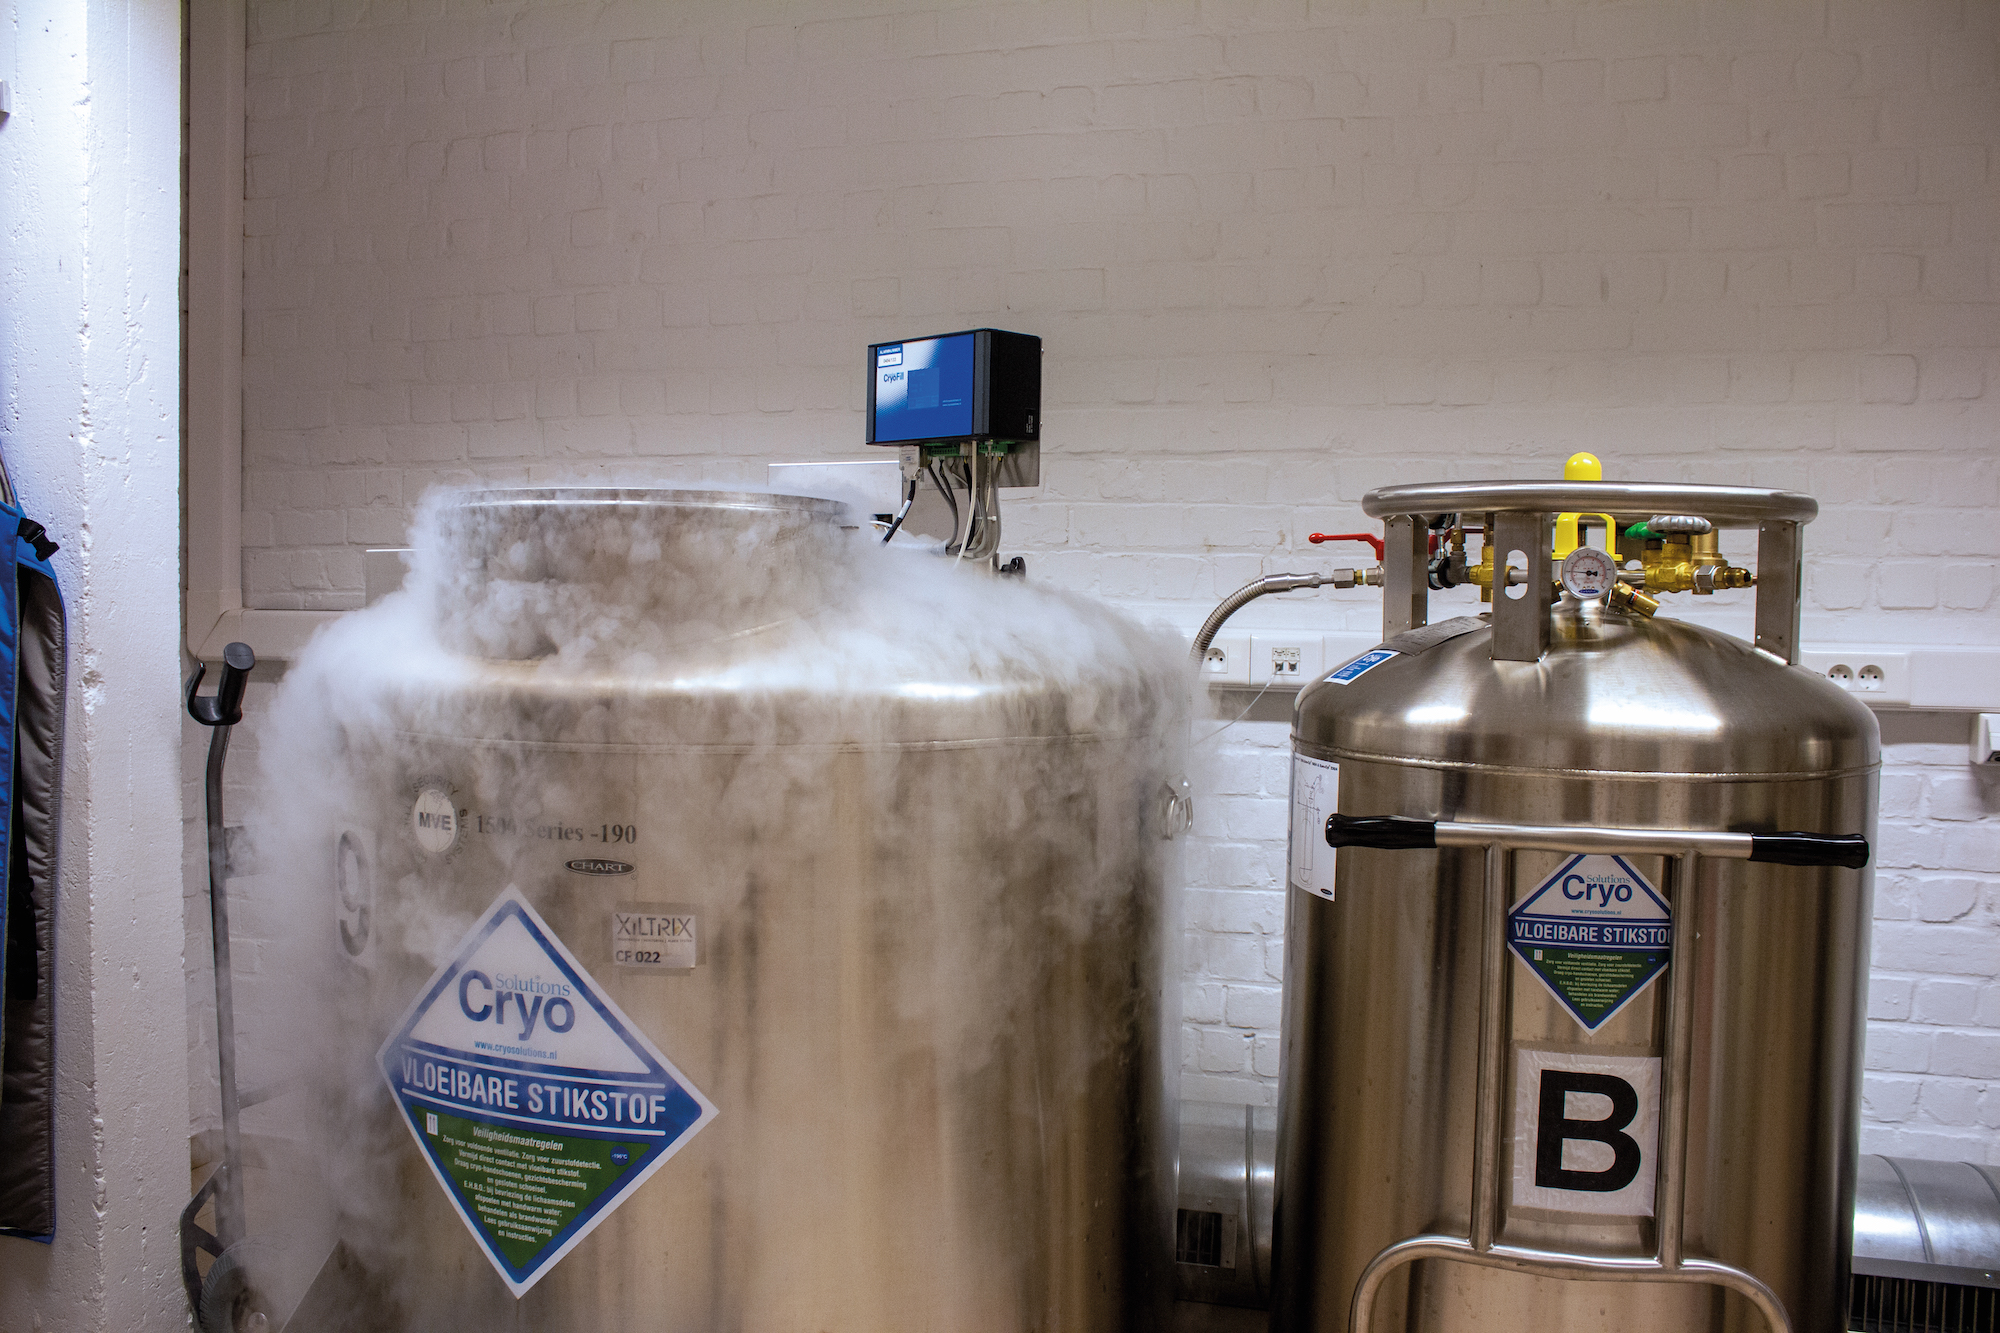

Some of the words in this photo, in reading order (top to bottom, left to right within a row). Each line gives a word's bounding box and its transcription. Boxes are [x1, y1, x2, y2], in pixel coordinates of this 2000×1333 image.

[419, 812, 451, 831] MVE
[525, 819, 584, 841] Series
[590, 824, 637, 844] -190
[570, 860, 626, 872] CHART
[1587, 874, 1631, 884] Solutions
[1562, 874, 1633, 908] Cryo
[1514, 921, 1599, 942] VLOEIBARE
[616, 950, 632, 962] CF
[635, 951, 661, 963] 022
[495, 973, 571, 997] Solutions
[459, 969, 575, 1041] Cryo
[474, 1041, 558, 1061] www.cryosolutions.nl
[402, 1055, 519, 1110] VLOEIBARE
[528, 1082, 666, 1125] STIKSTOF
[473, 1126, 564, 1152] Veiligheidsmaatregelen
[1535, 1069, 1641, 1202] B
[521, 1152, 536, 1163] Zorg
